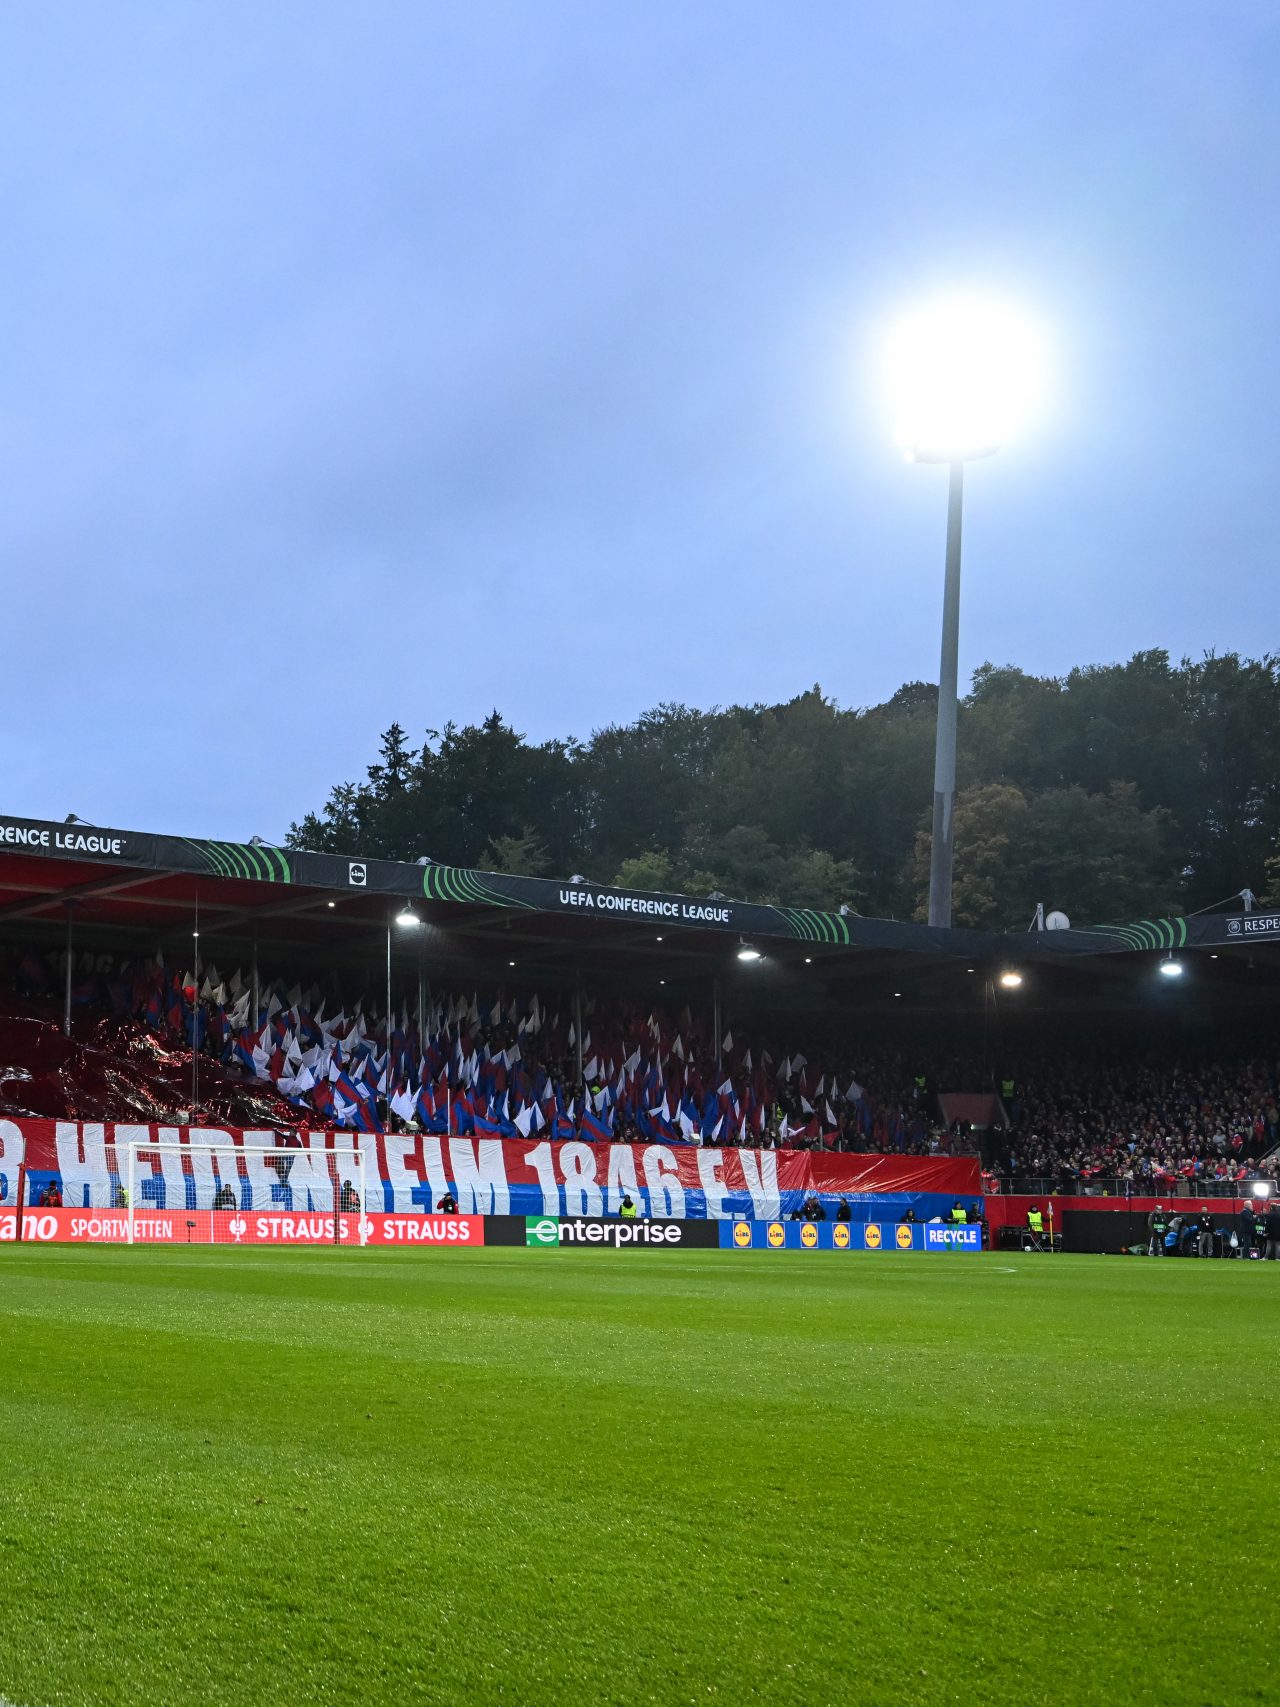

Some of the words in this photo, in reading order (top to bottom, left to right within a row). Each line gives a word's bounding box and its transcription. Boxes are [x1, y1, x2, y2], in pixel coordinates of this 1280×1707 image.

[559, 890, 595, 908] UEFA
[597, 894, 679, 917] CONFERENCE
[1244, 918, 1280, 932] RESPE
[55, 1121, 509, 1217] HEIDENHEIM
[524, 1141, 686, 1219] 1846
[70, 1218, 173, 1238] SPORTWETTEN
[256, 1217, 349, 1239] STRAUSS
[383, 1219, 470, 1241] STRAUSS
[526, 1218, 682, 1248] enterprise
[929, 1230, 977, 1243] RECYCLE
